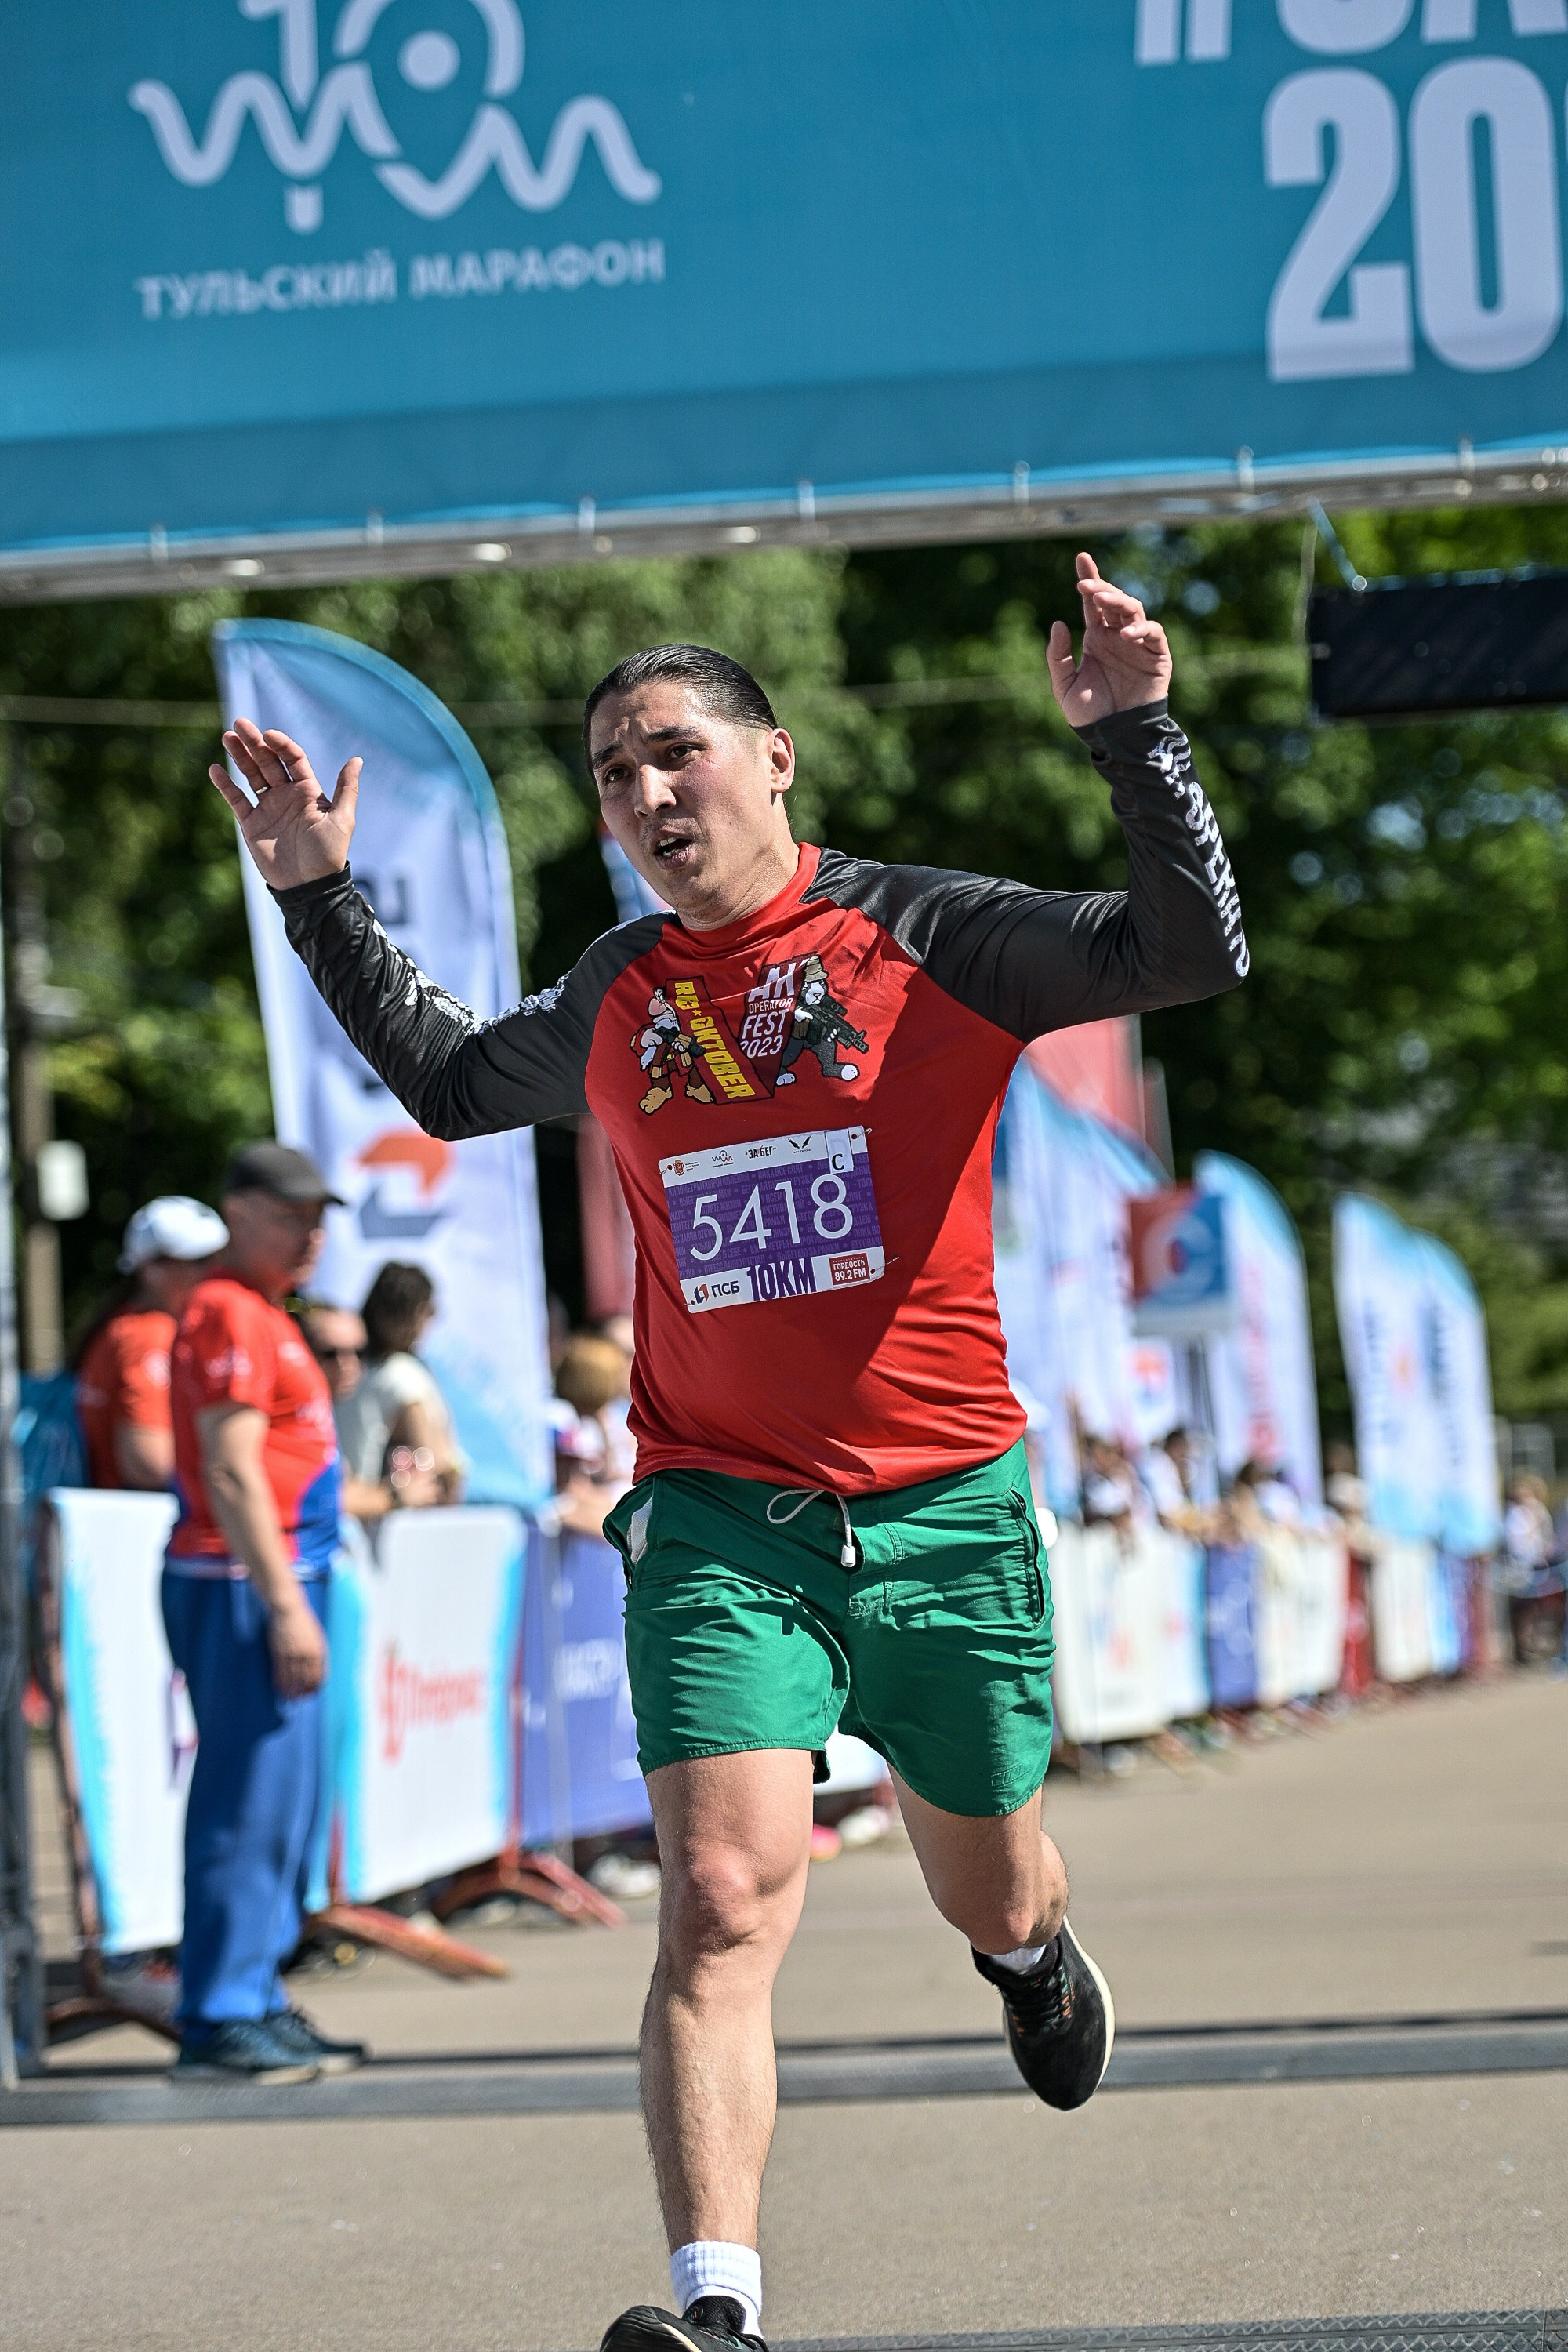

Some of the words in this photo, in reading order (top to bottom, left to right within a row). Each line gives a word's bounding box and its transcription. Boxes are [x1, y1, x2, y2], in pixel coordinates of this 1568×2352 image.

[1262, 56, 1568, 382] 20
[133, 249, 397, 320] ТУЛЬСКИЙ
[408, 238, 665, 299] МАРАФОН
[749, 997, 793, 1014] OPERATOR
[742, 1008, 790, 1040] FEST
[740, 1034, 784, 1058] 2023
[690, 1174, 853, 1261] 5418
[833, 1259, 866, 1271] ГОРДОСТЬ
[833, 1269, 853, 1282] 89.2
[852, 1267, 867, 1279] FM
[711, 1279, 741, 1298] ПСБ
